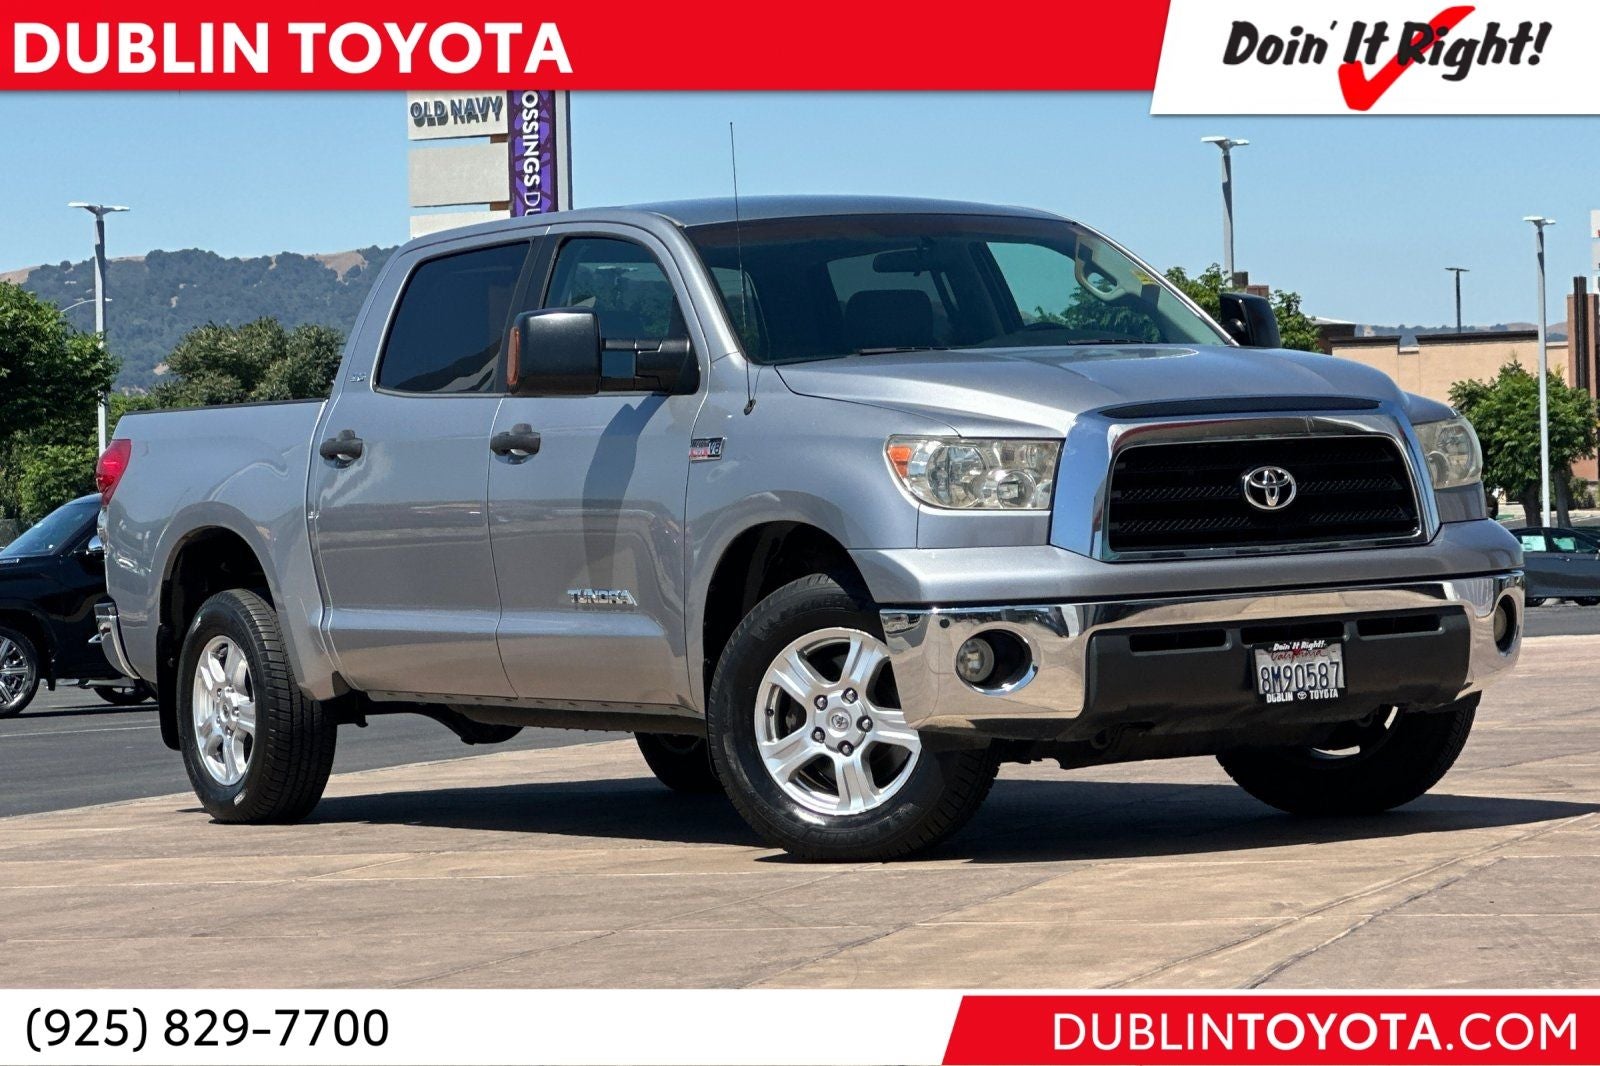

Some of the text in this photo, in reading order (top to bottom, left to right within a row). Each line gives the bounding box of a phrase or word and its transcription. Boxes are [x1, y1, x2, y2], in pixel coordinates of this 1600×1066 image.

[410, 96, 504, 127] OLD NAVY
[521, 90, 541, 187] OSSINGS
[1261, 661, 1340, 694] 8M90587
[1266, 688, 1339, 703] DUBLIN TOYOTA
